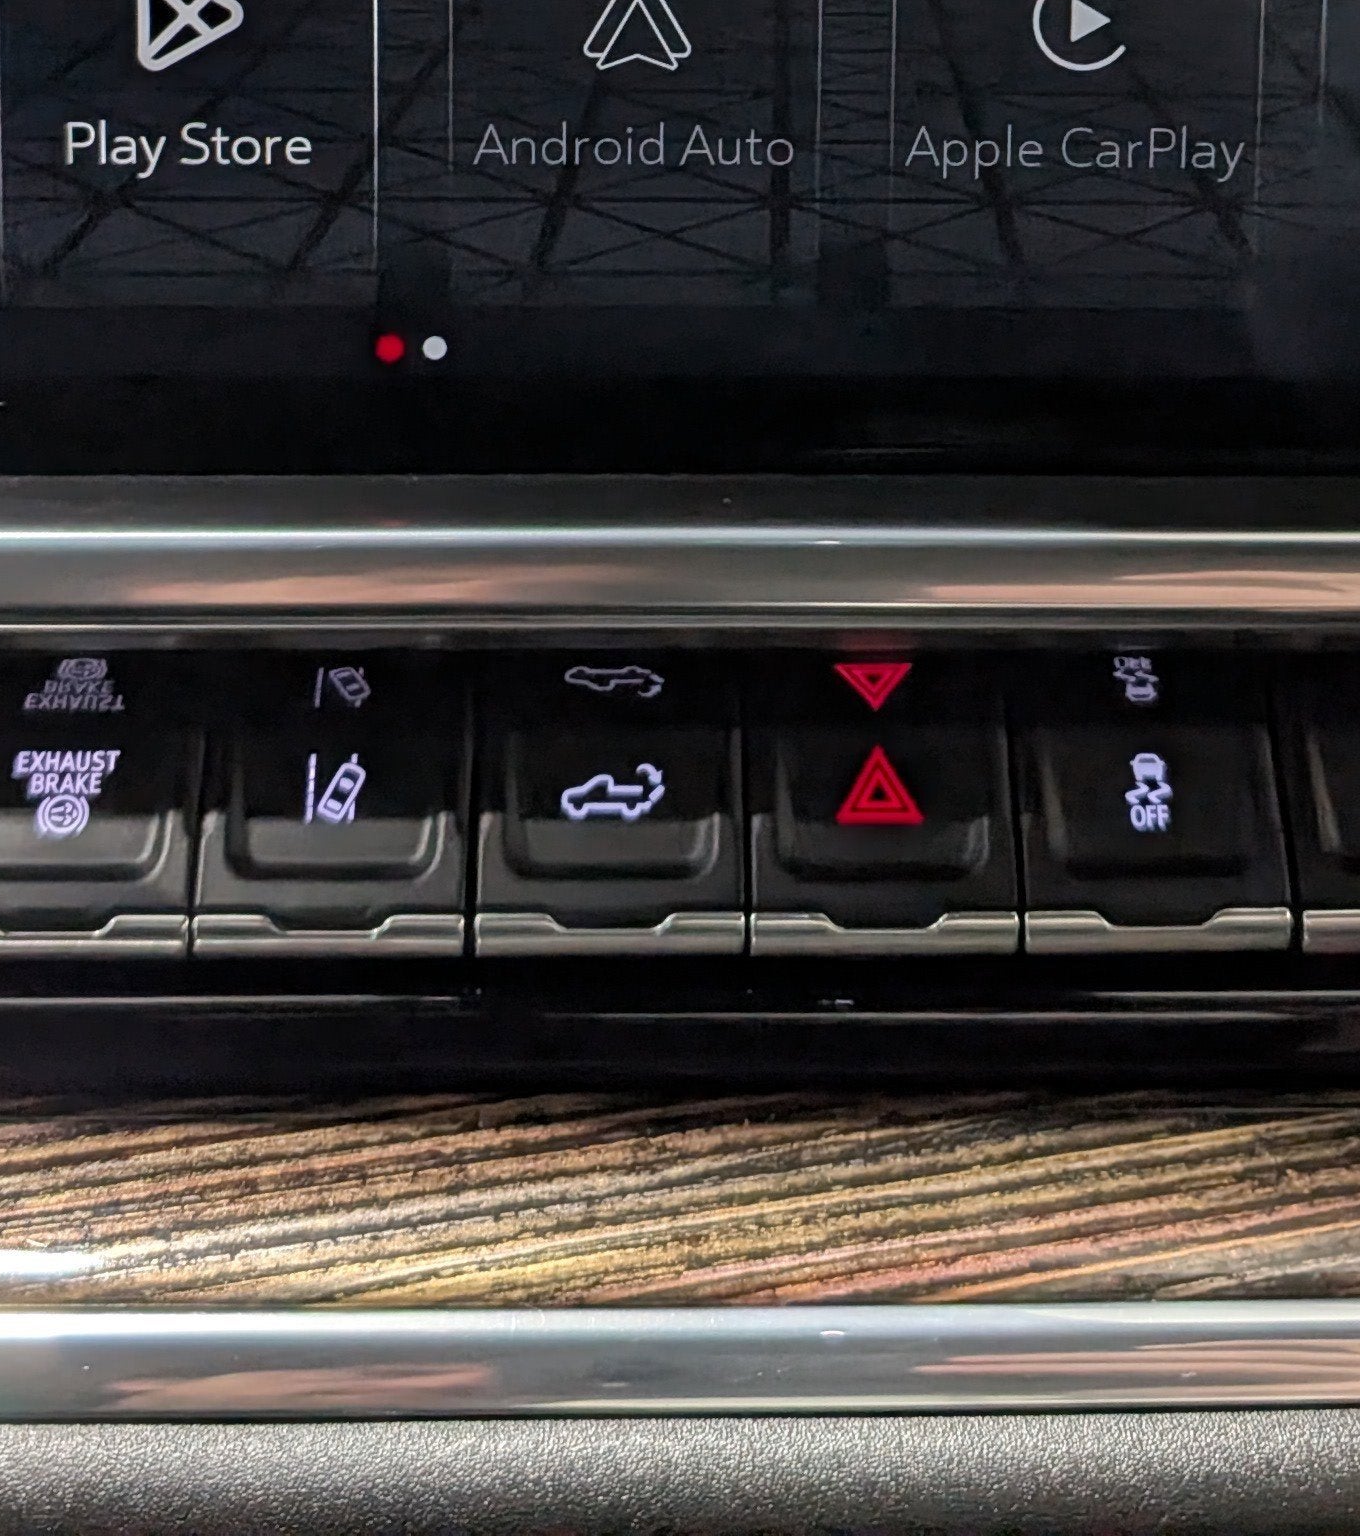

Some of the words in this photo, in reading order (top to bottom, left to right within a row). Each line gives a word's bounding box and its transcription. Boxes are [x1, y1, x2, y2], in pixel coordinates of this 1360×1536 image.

[65, 120, 167, 179] Play
[180, 121, 312, 166] Store
[473, 120, 666, 166] Android
[679, 123, 795, 167] Auto
[904, 124, 1044, 180] Apple
[1060, 124, 1245, 183] CarPlay
[14, 750, 121, 774] EXHAUST
[30, 772, 103, 796] BRAKE
[1130, 804, 1169, 831] OFF
